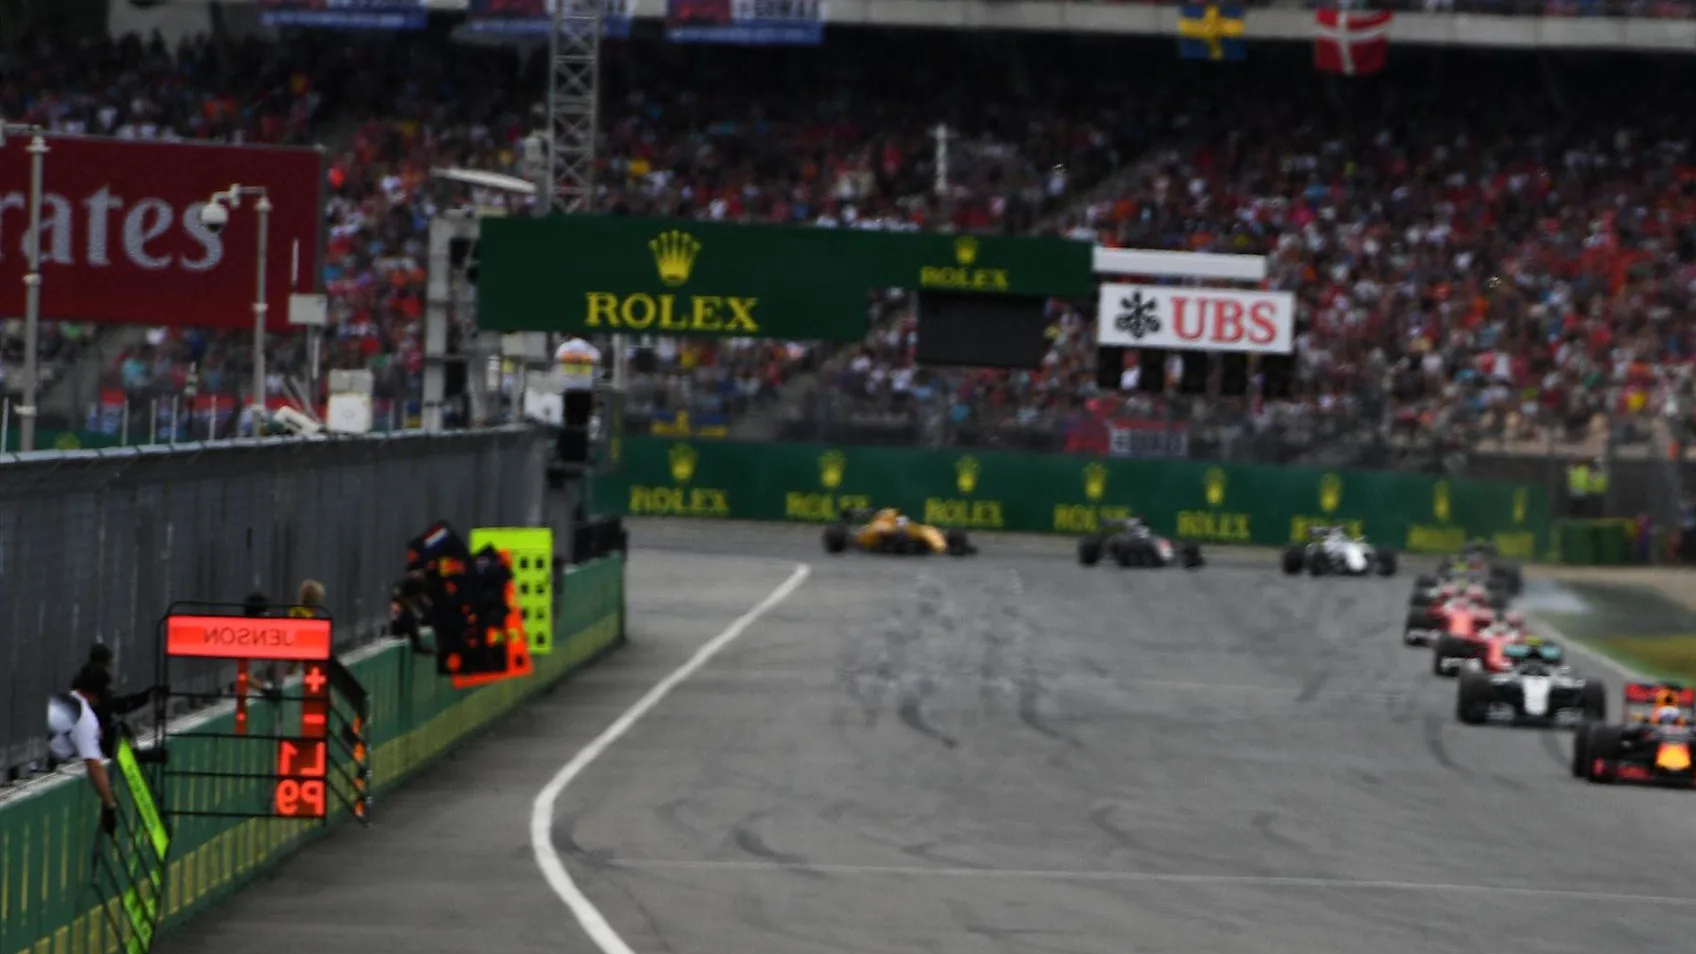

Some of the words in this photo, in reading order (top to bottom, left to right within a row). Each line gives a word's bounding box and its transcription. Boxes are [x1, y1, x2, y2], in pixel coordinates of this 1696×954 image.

[920, 266, 1009, 291] ROLEX
[586, 291, 758, 332] ROLEX
[1172, 296, 1277, 344] UBS
[629, 486, 729, 517] ROLEX
